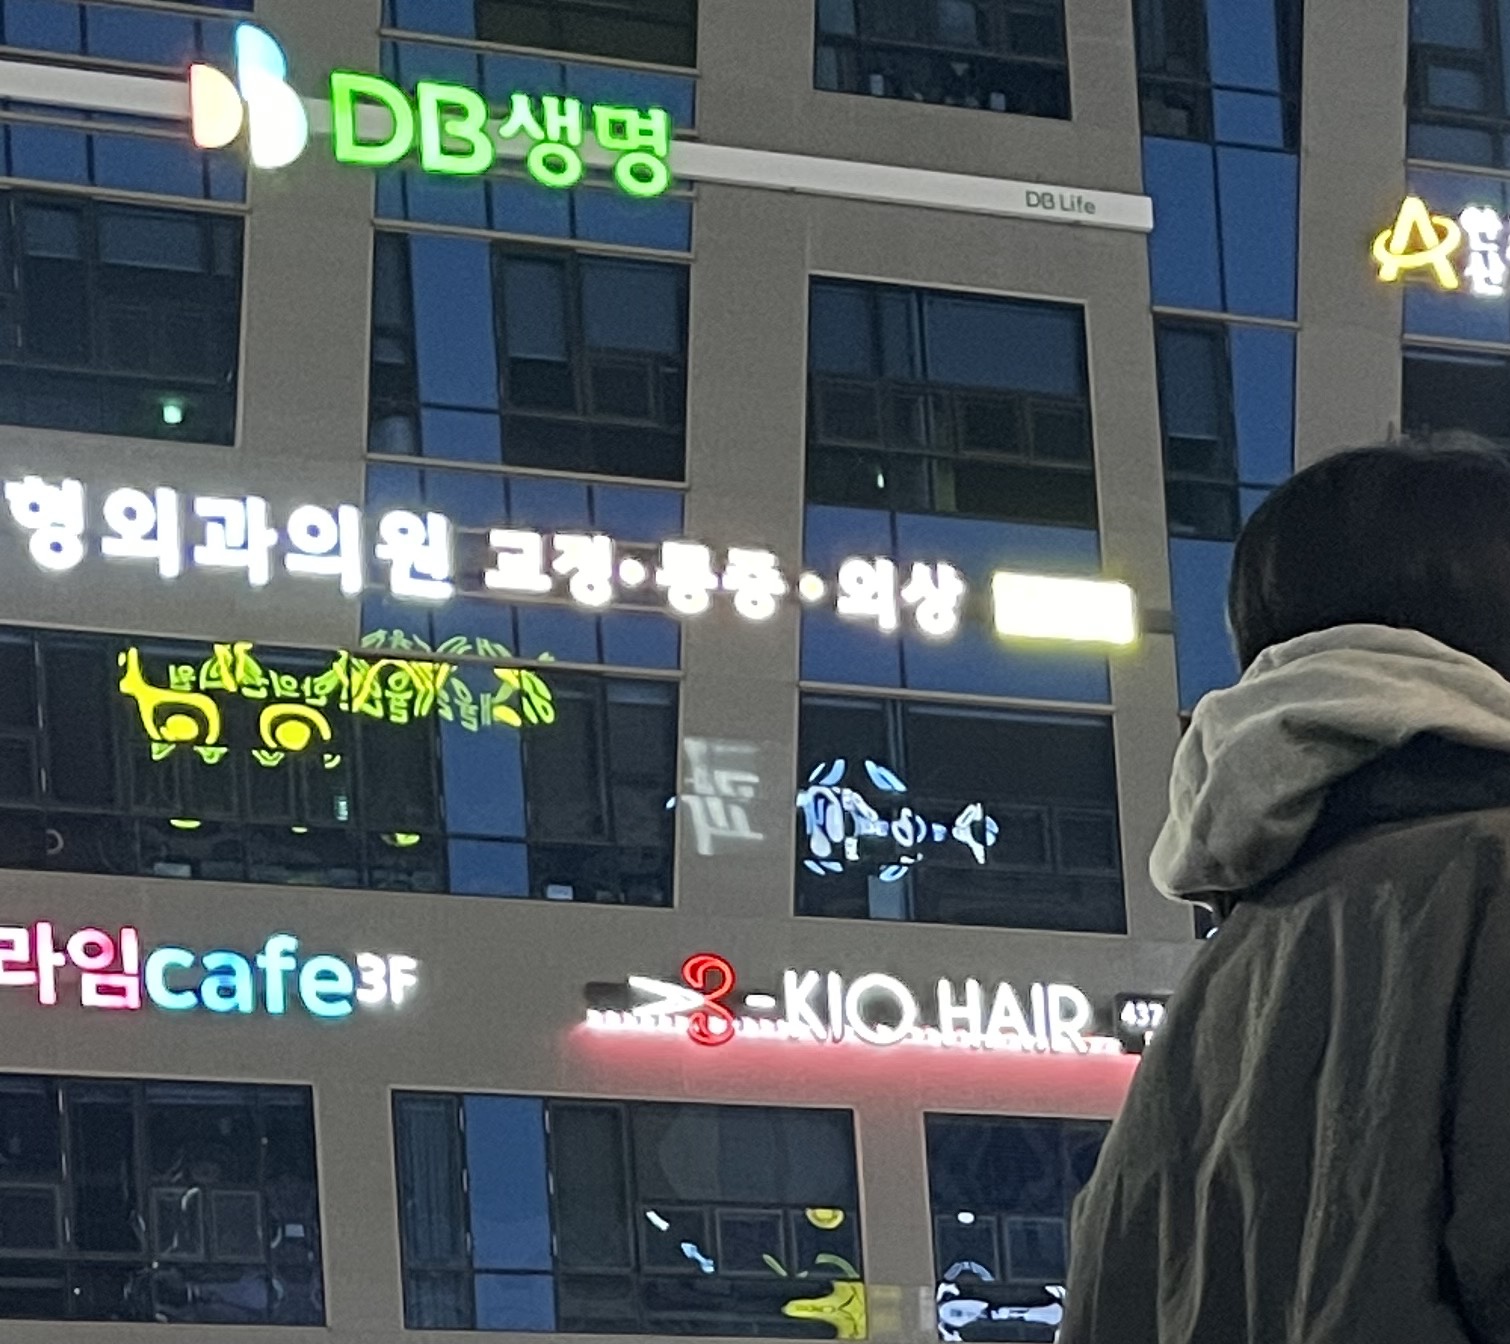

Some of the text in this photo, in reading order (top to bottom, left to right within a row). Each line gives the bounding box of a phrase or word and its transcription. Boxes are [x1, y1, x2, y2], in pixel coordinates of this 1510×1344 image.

[330, 70, 673, 197] DB생명
[1025, 190, 1096, 215] DB Life
[936, 978, 1093, 1055] HAIR
